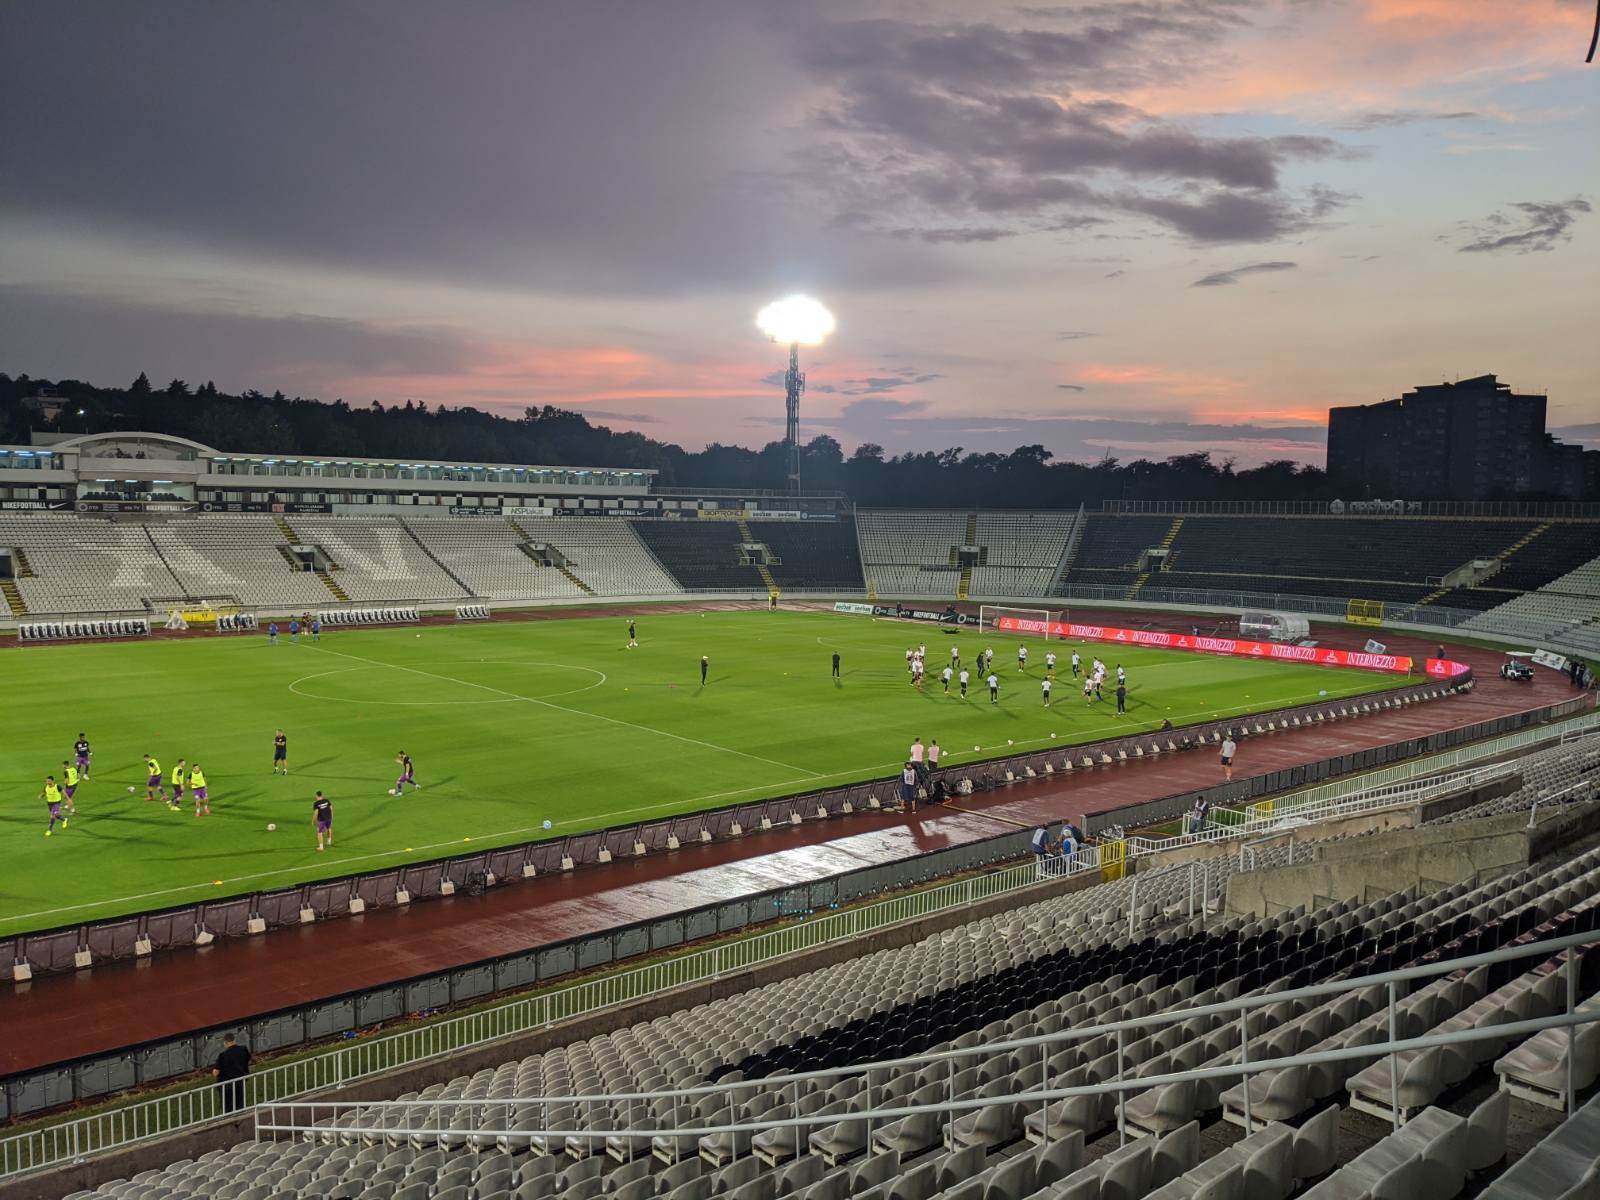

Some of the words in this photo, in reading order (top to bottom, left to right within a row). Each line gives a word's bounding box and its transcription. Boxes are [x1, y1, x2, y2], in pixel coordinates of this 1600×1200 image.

[2, 501, 47, 509] NIKEFOOTBALL
[1132, 631, 1170, 645] INTERMEZZO
[1195, 637, 1236, 652] INTERMEZZO
[1270, 645, 1316, 660] INTERMEZZO
[1347, 652, 1396, 669] INTERMEZZO
